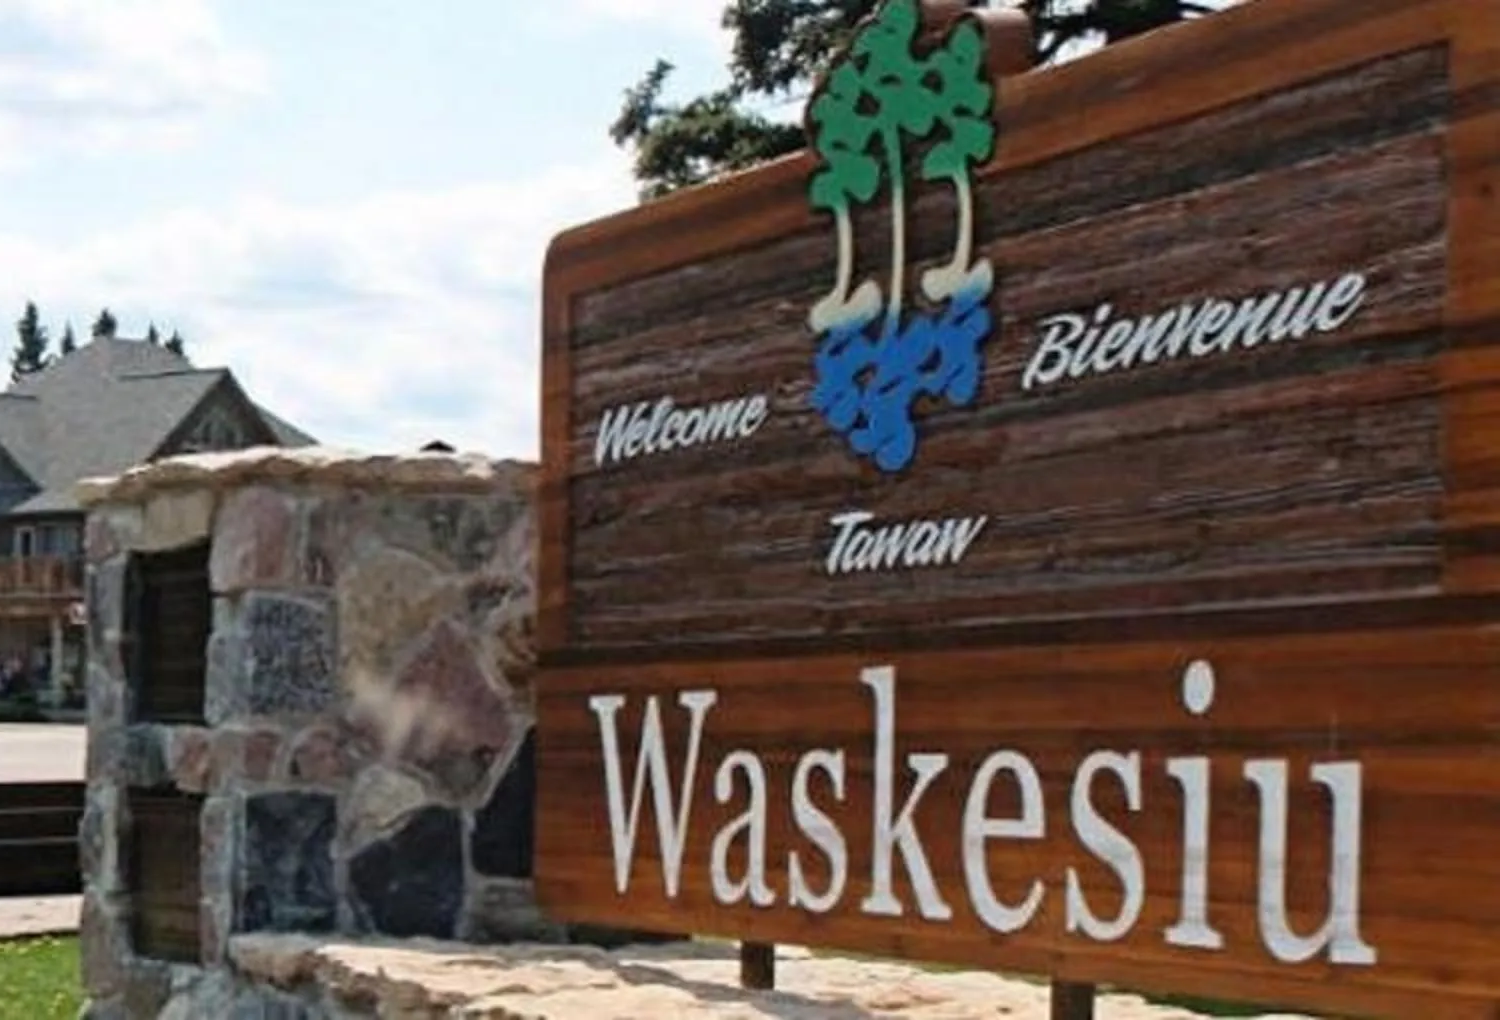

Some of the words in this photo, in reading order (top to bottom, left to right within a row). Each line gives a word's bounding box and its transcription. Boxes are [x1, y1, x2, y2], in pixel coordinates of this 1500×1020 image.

[1022, 271, 1367, 391] Bienvenue
[593, 391, 769, 468] Welcome
[823, 511, 988, 576] Tawaw
[589, 660, 1378, 966] Waskesiu
